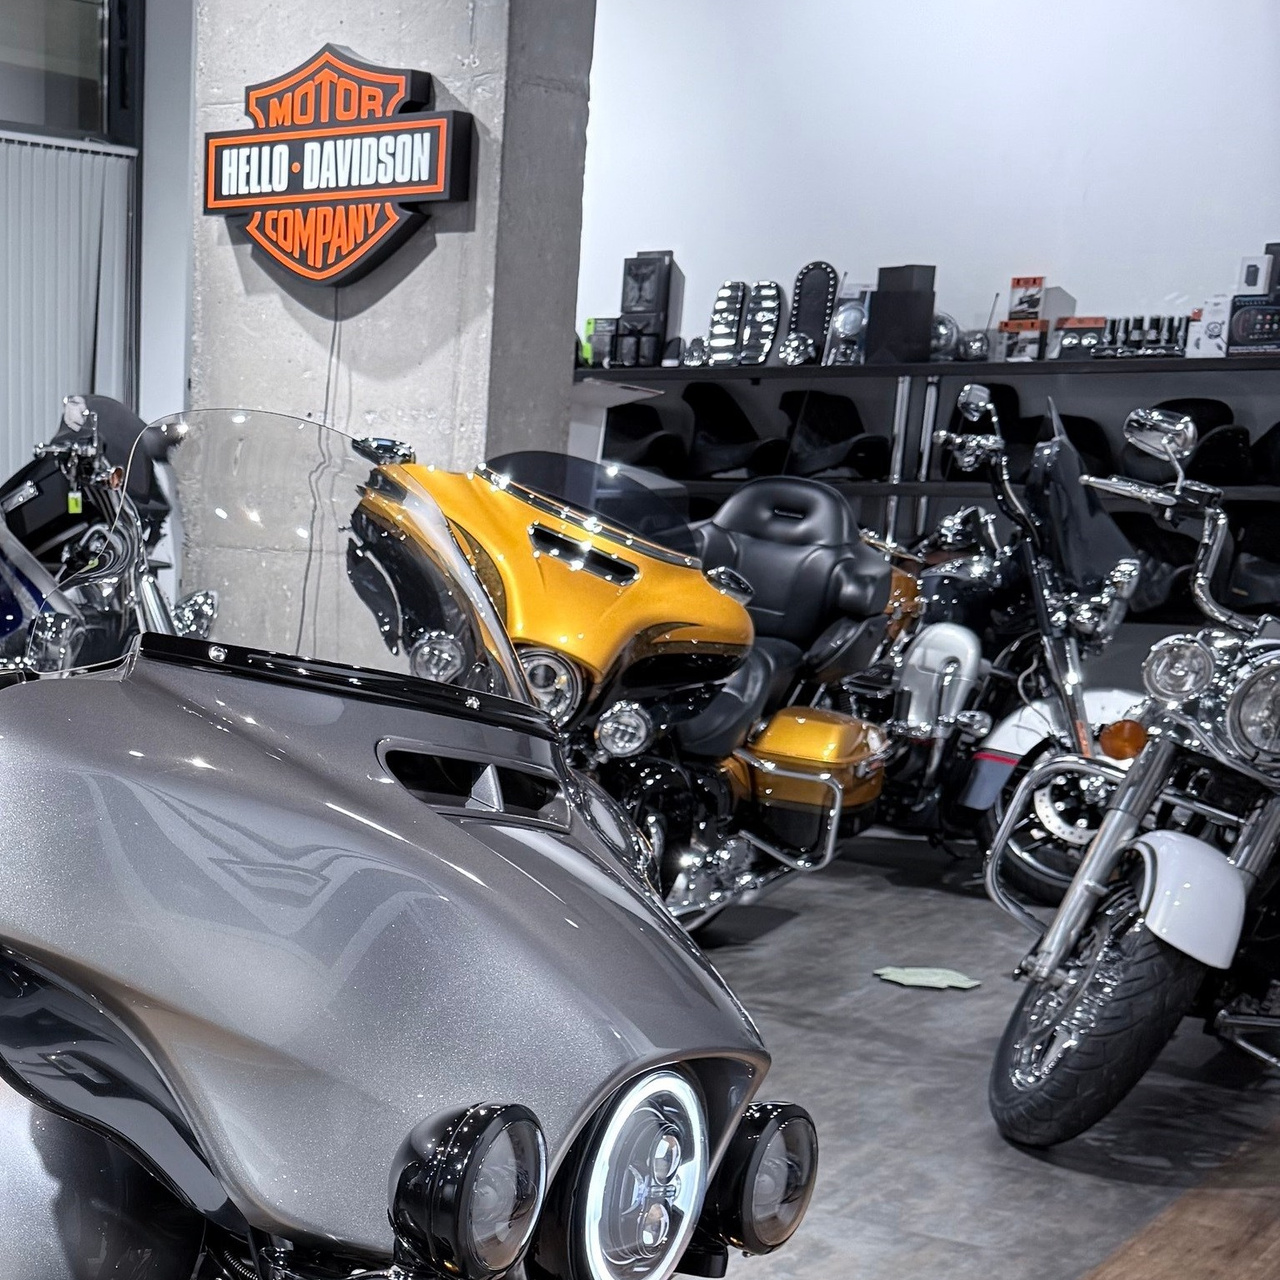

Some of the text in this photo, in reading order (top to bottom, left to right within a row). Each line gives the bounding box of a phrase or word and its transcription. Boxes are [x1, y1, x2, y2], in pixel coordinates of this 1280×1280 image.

[268, 68, 384, 128] MOTOR
[221, 132, 431, 196] HELLO DAVIDSON
[264, 203, 381, 268] COMPANY
